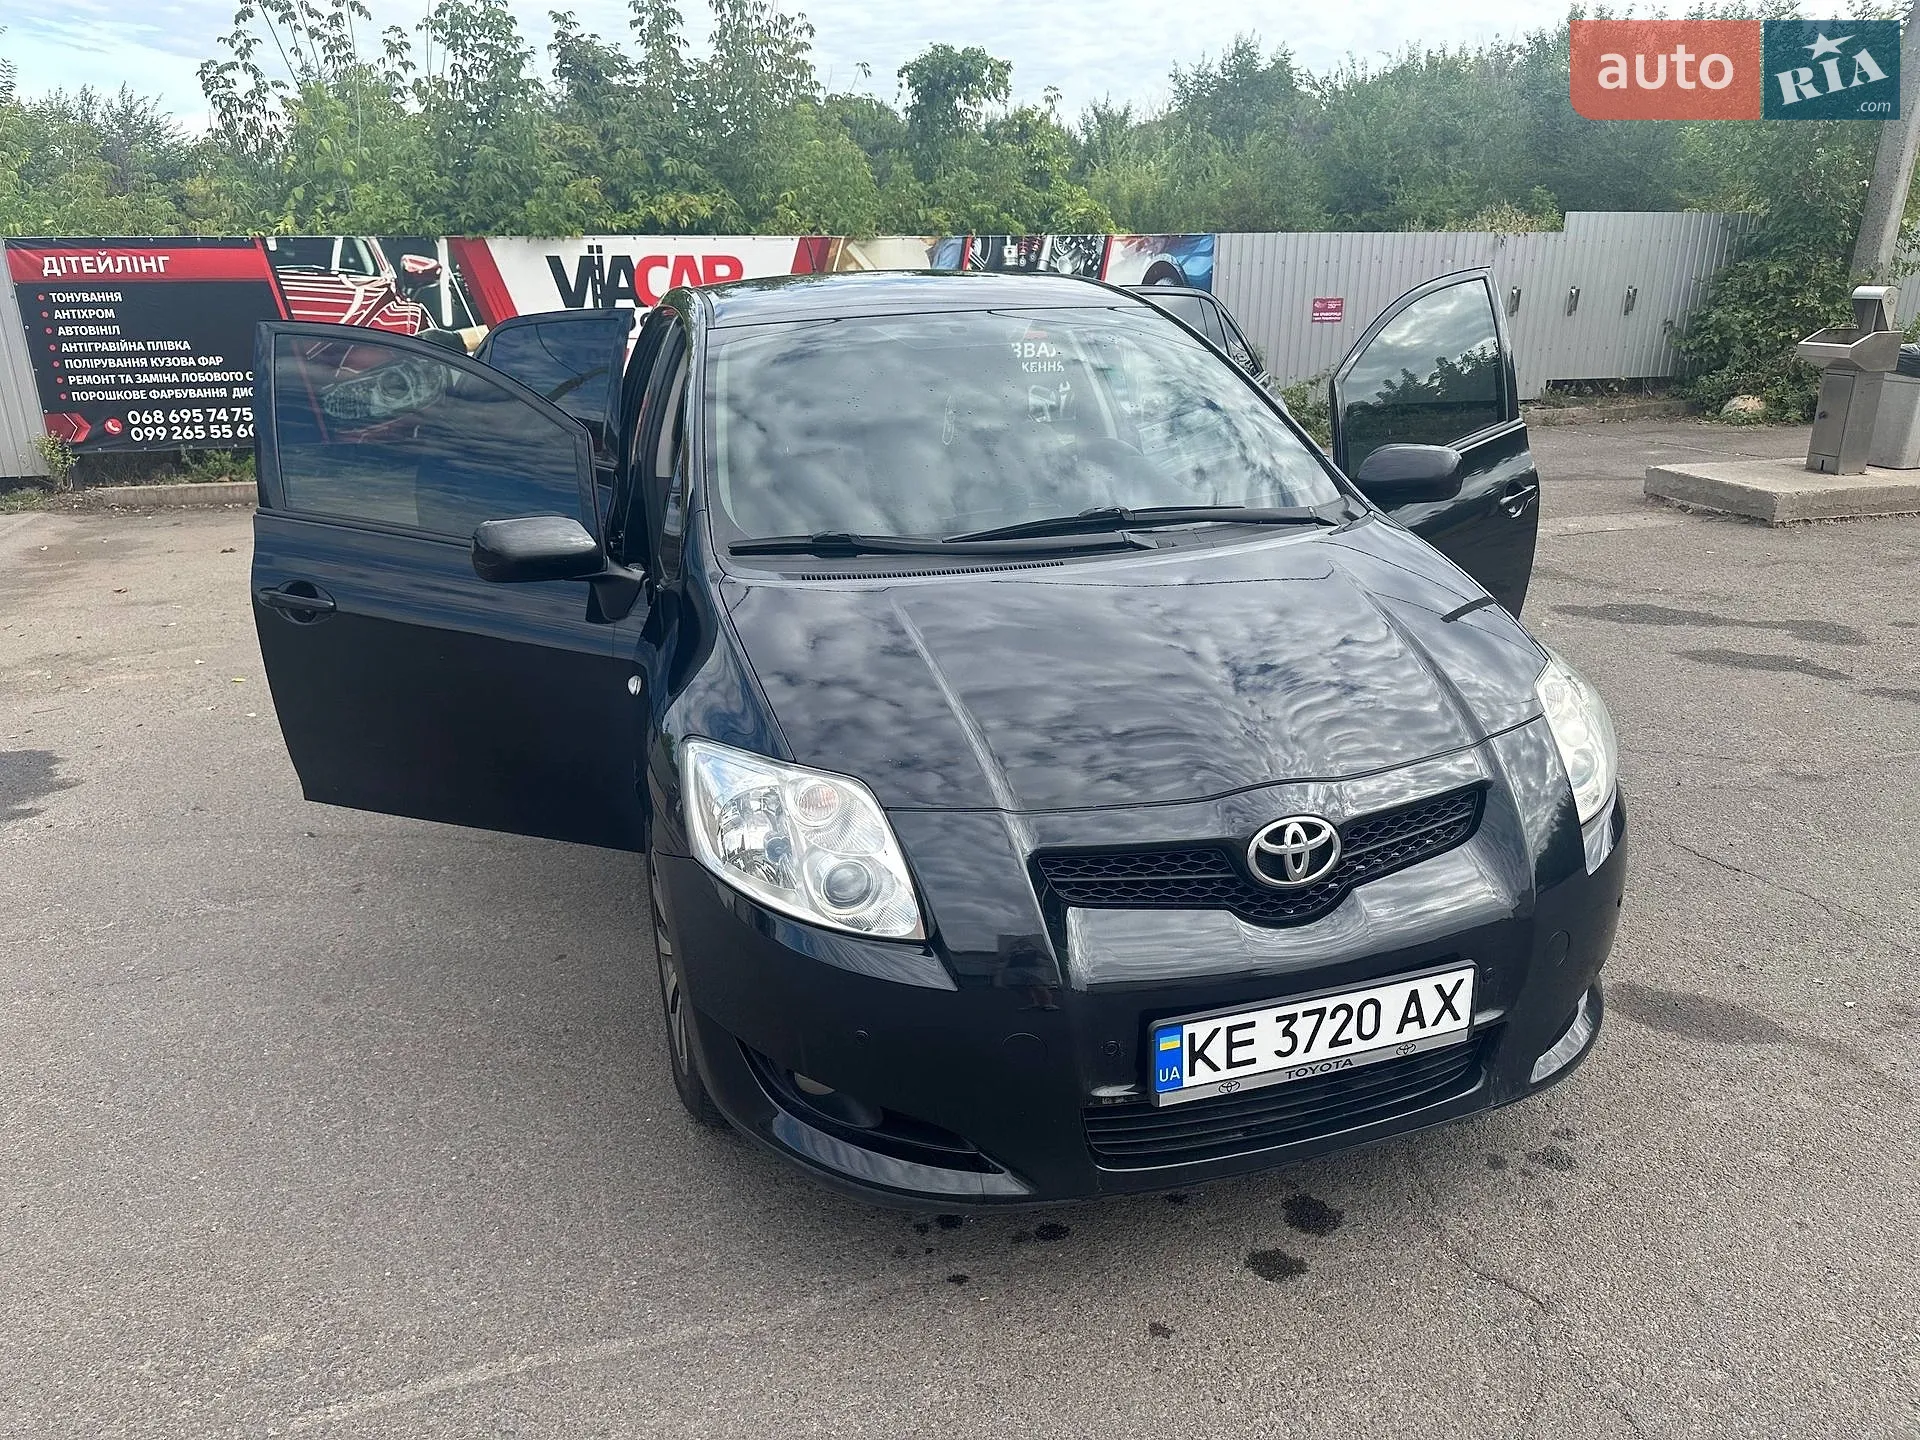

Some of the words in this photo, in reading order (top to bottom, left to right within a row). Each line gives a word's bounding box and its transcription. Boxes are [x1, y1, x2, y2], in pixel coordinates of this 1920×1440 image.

[42, 251, 170, 276] ДІТЕЙЛІНГ
[49, 291, 122, 302] ТОНУВАННЯ
[54, 309, 115, 319] АНТІХРОМ
[58, 325, 121, 336] АВТОВІНІЛ
[61, 339, 145, 352] АНТІГРАВІЙНА
[147, 341, 191, 351] ПЛІВКА
[64, 358, 148, 368] ПОЛІРУВАННЯ
[150, 356, 196, 367] КУЗОВА
[198, 356, 224, 366] ФАР
[68, 374, 115, 385] РЕМОНТ
[118, 374, 134, 384] ТА
[135, 373, 179, 383] ЗАМІНА
[181, 371, 244, 382] ЛОБОВОГО
[72, 389, 147, 401] ПОРОШКОВЕ
[149, 388, 227, 400] ФАРБУВАННЯ
[127, 410, 165, 425] 068
[168, 408, 204, 423] 695
[206, 408, 229, 422] 74
[231, 407, 254, 421] 75
[130, 426, 167, 441] 099
[170, 425, 205, 440] 265
[210, 424, 233, 439] 55
[1188, 1020, 1257, 1077] KE
[1274, 997, 1382, 1058] 3720
[1396, 978, 1465, 1035] AX
[1159, 1066, 1181, 1082] UA
[1285, 1058, 1354, 1080] TOYOTA
